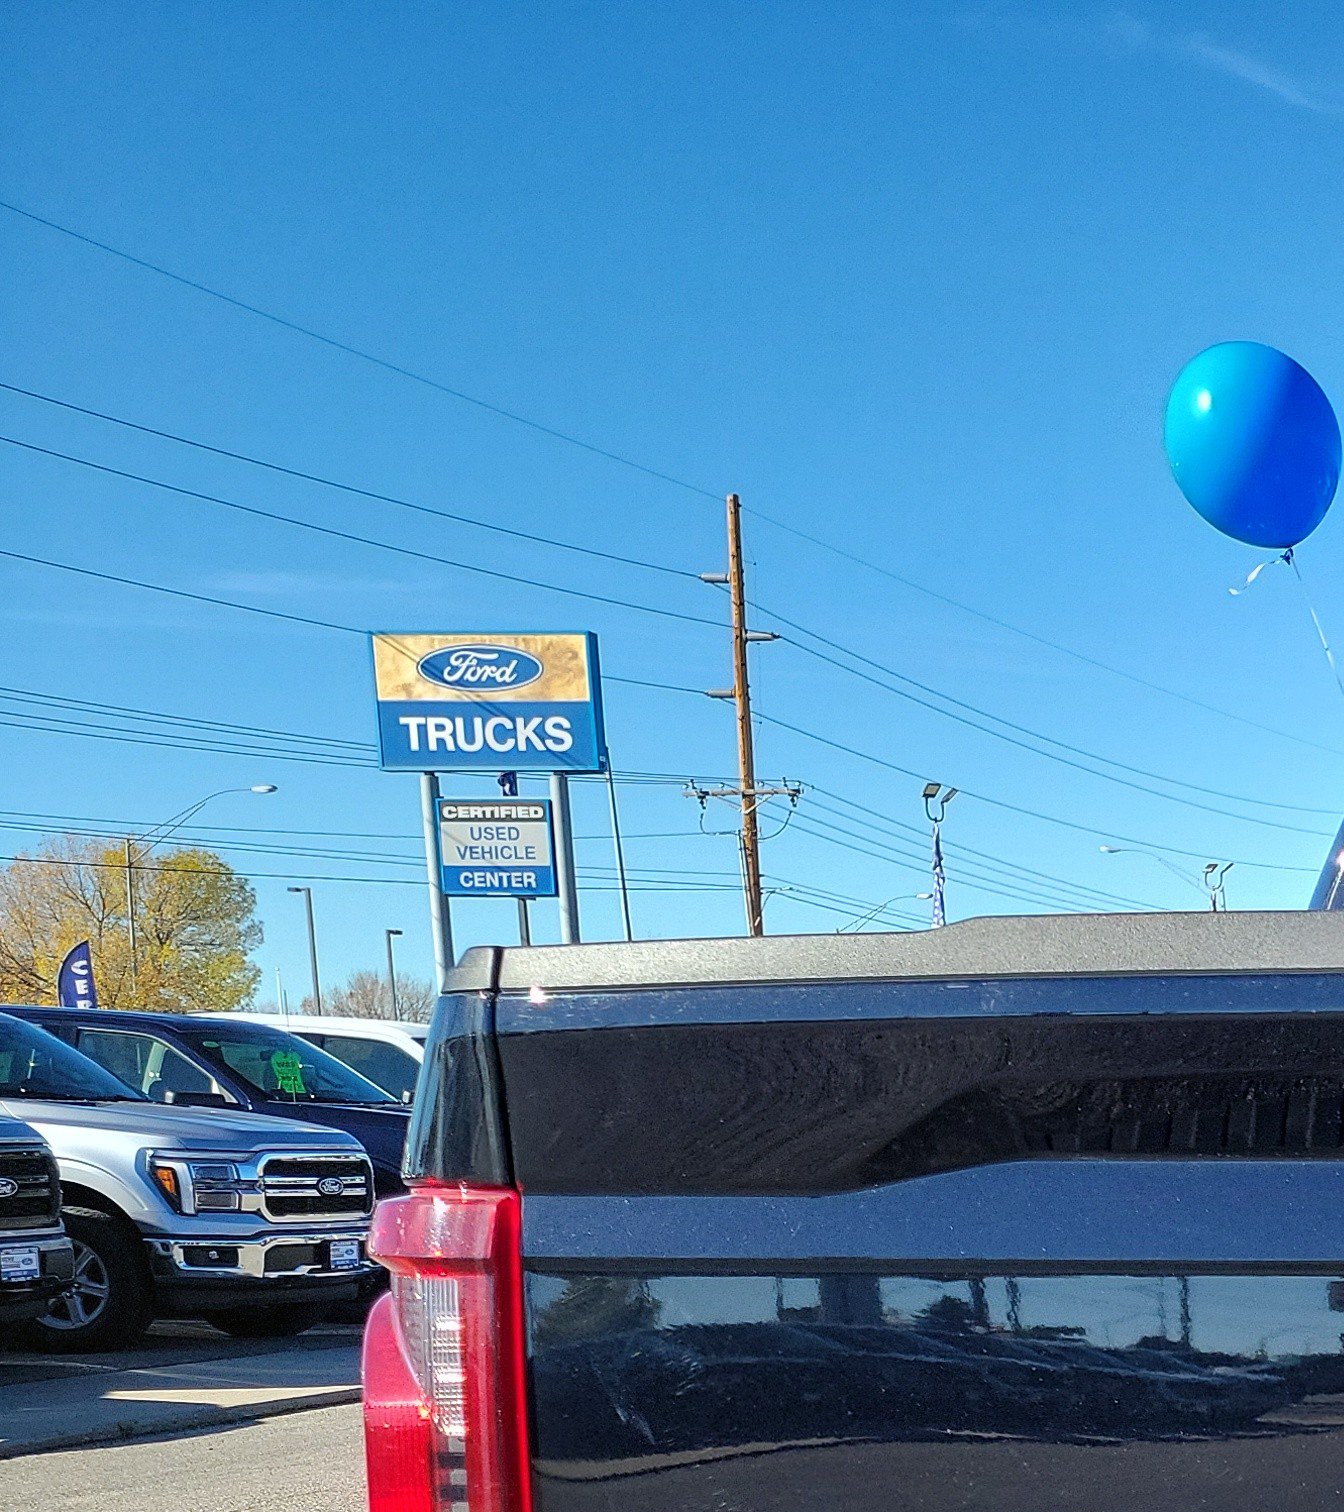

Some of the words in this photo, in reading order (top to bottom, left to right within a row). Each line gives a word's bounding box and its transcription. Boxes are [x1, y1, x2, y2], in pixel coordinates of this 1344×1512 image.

[443, 650, 518, 683] Ford
[399, 716, 574, 753] TRUCKS
[441, 804, 544, 820] CERTIFIED
[469, 826, 520, 842] USED
[456, 845, 536, 861] VEHICLE
[459, 871, 537, 888] CENTER
